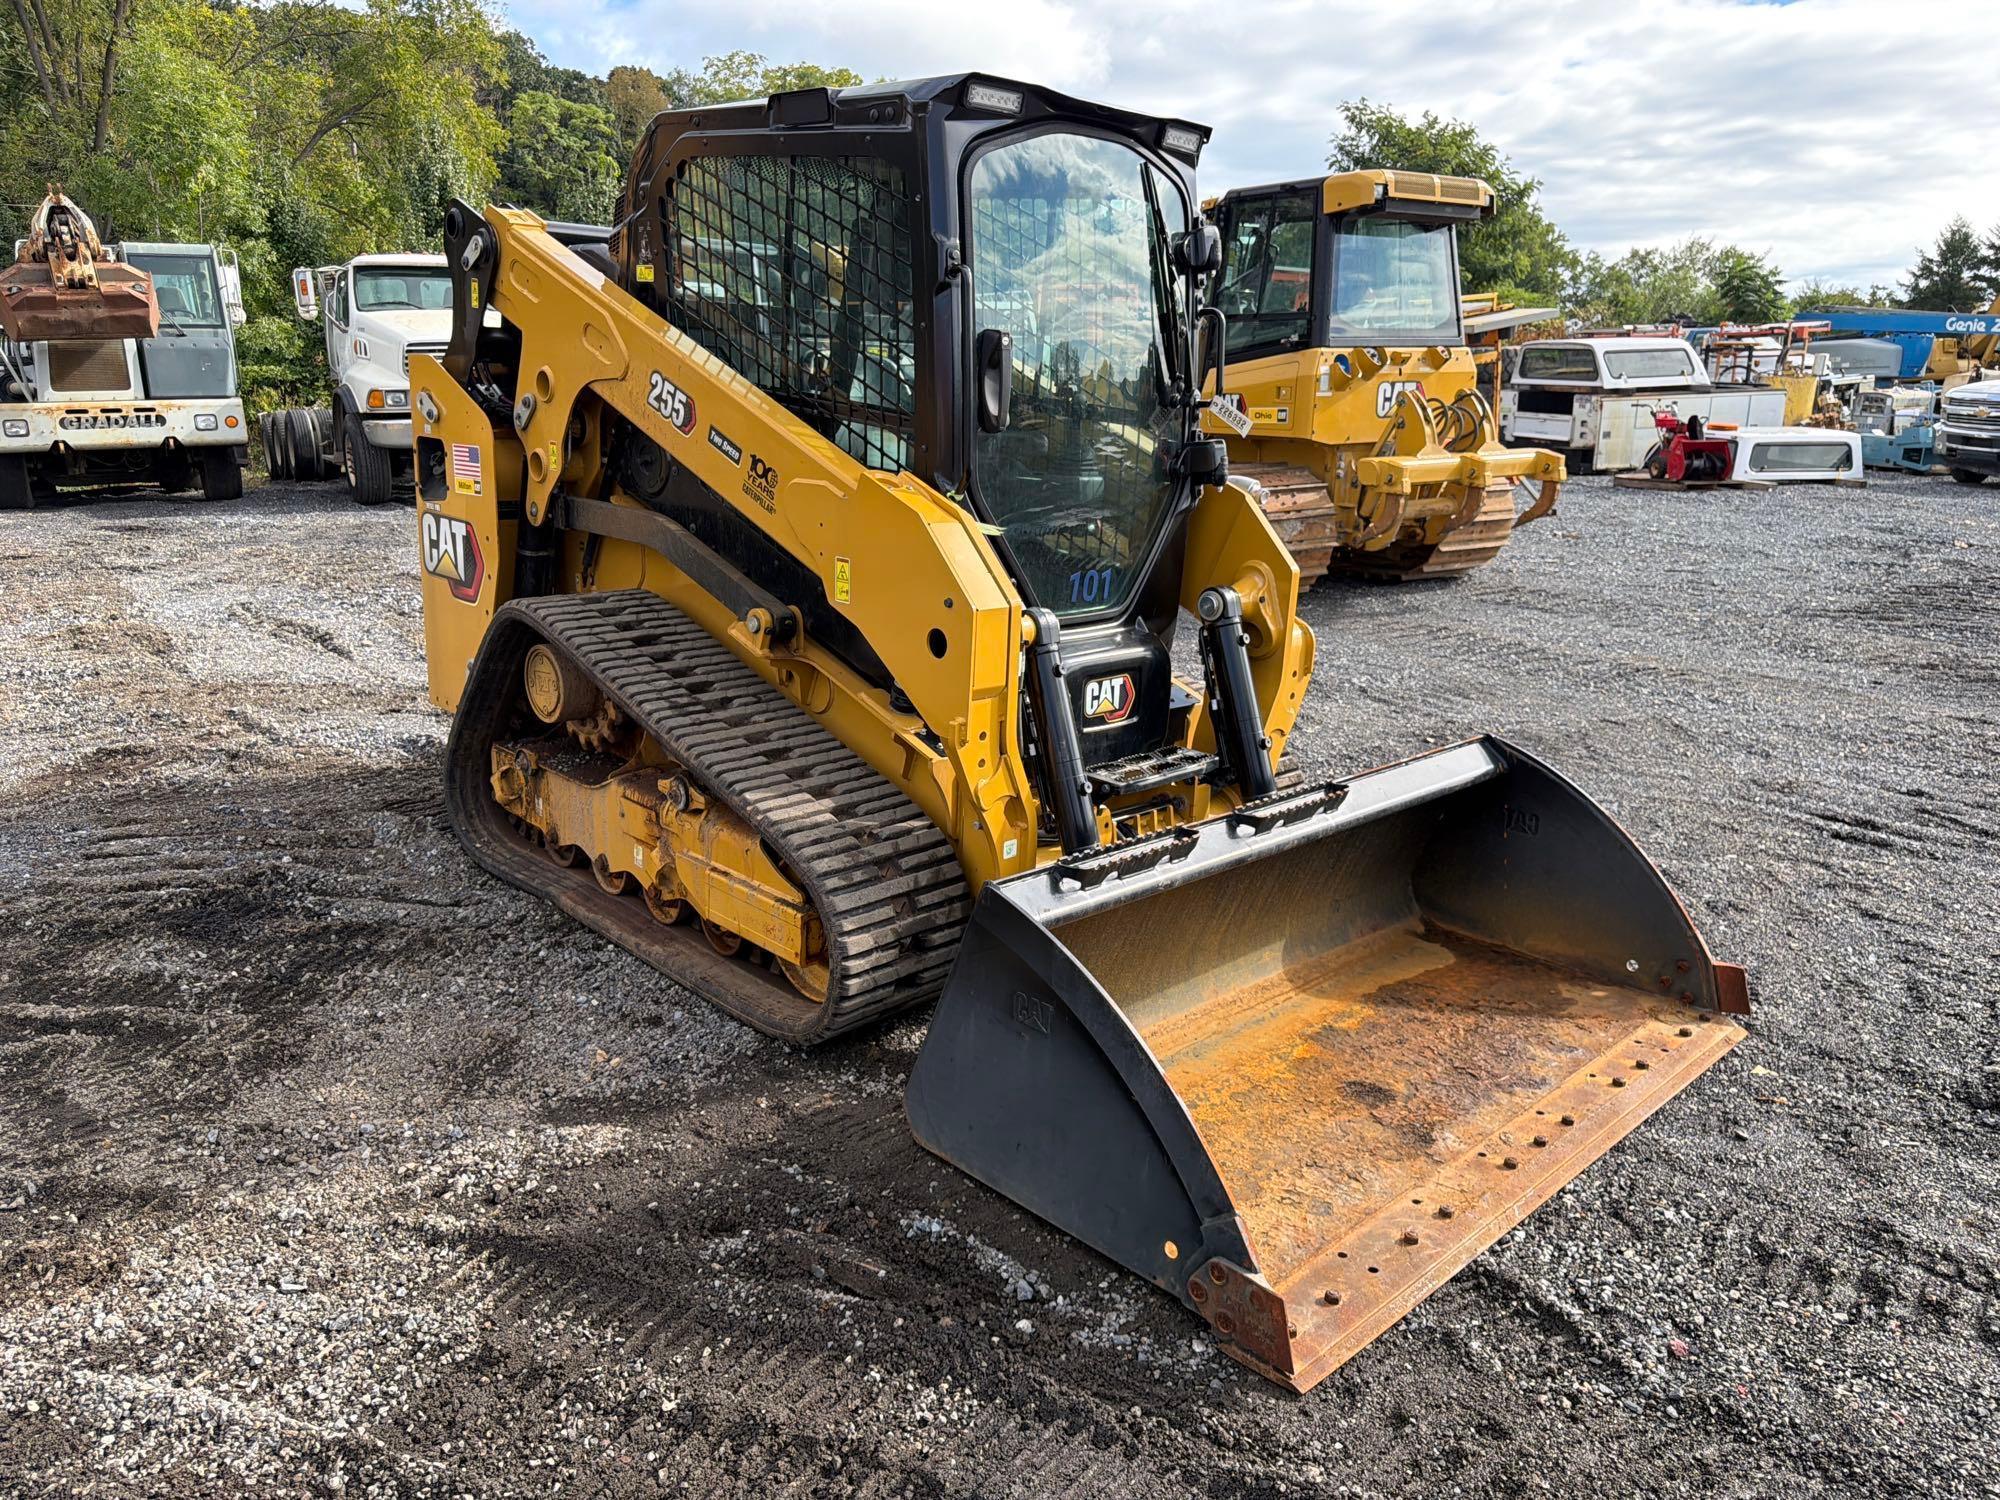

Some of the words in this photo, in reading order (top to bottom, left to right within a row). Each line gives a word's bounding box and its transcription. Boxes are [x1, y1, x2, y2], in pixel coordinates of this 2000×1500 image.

[1945, 316, 1986, 332] Genie
[647, 372, 688, 428] 255
[1254, 411, 1273, 420] Ohio
[63, 413, 163, 430] GRADALL
[746, 470, 776, 501] YEARS
[422, 512, 467, 582] CAT
[1069, 568, 1112, 603] 101
[1085, 676, 1124, 716] CAT
[1012, 990, 1054, 1034] CAT
